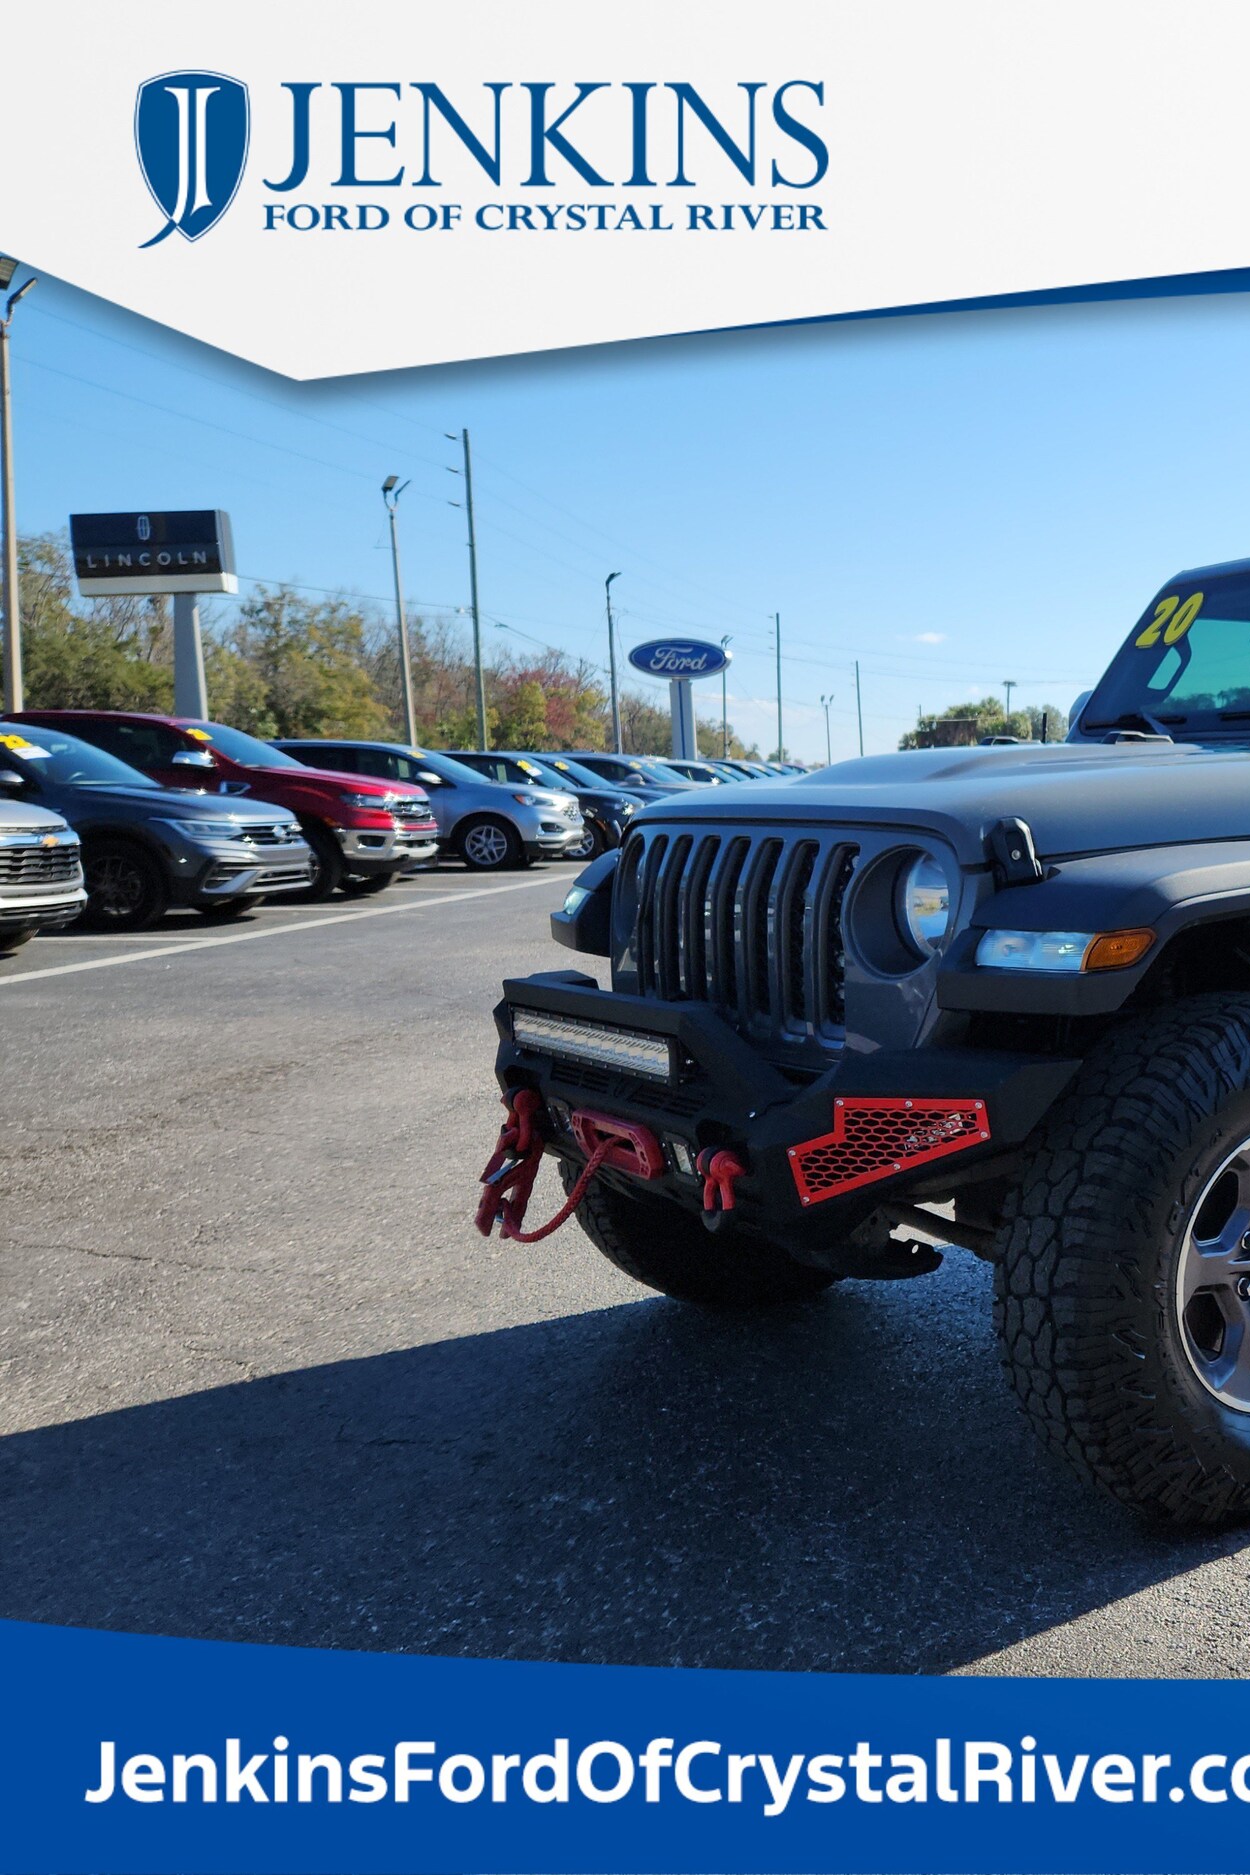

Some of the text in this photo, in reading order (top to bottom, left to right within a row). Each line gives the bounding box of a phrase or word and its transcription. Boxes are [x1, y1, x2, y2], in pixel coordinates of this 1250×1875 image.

[86, 551, 207, 569] LINCOLN
[1135, 592, 1204, 649] 20
[649, 646, 708, 671] Ford
